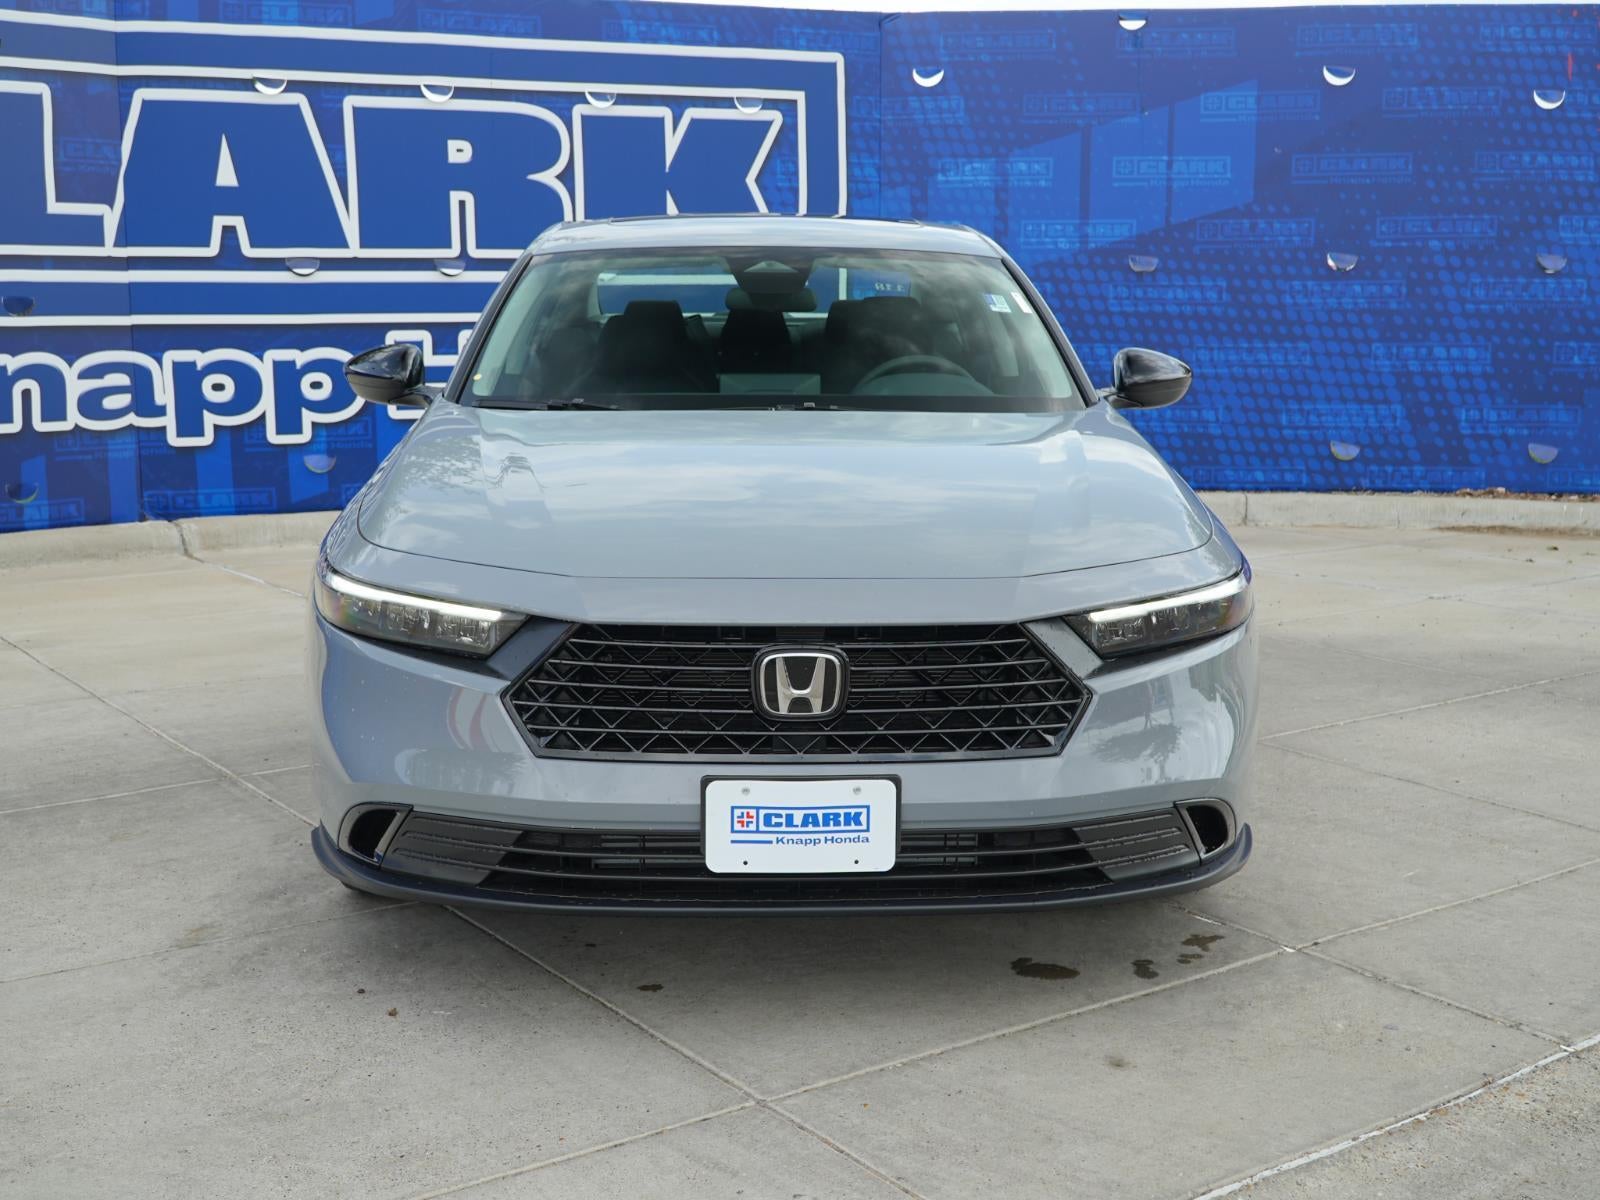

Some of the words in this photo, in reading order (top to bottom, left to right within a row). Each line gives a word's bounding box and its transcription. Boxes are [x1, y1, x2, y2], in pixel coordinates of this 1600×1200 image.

[1138, 160, 1225, 173] CLARK
[763, 812, 863, 828] CLARK
[776, 836, 821, 846] Knapp
[824, 835, 869, 844] Honda
